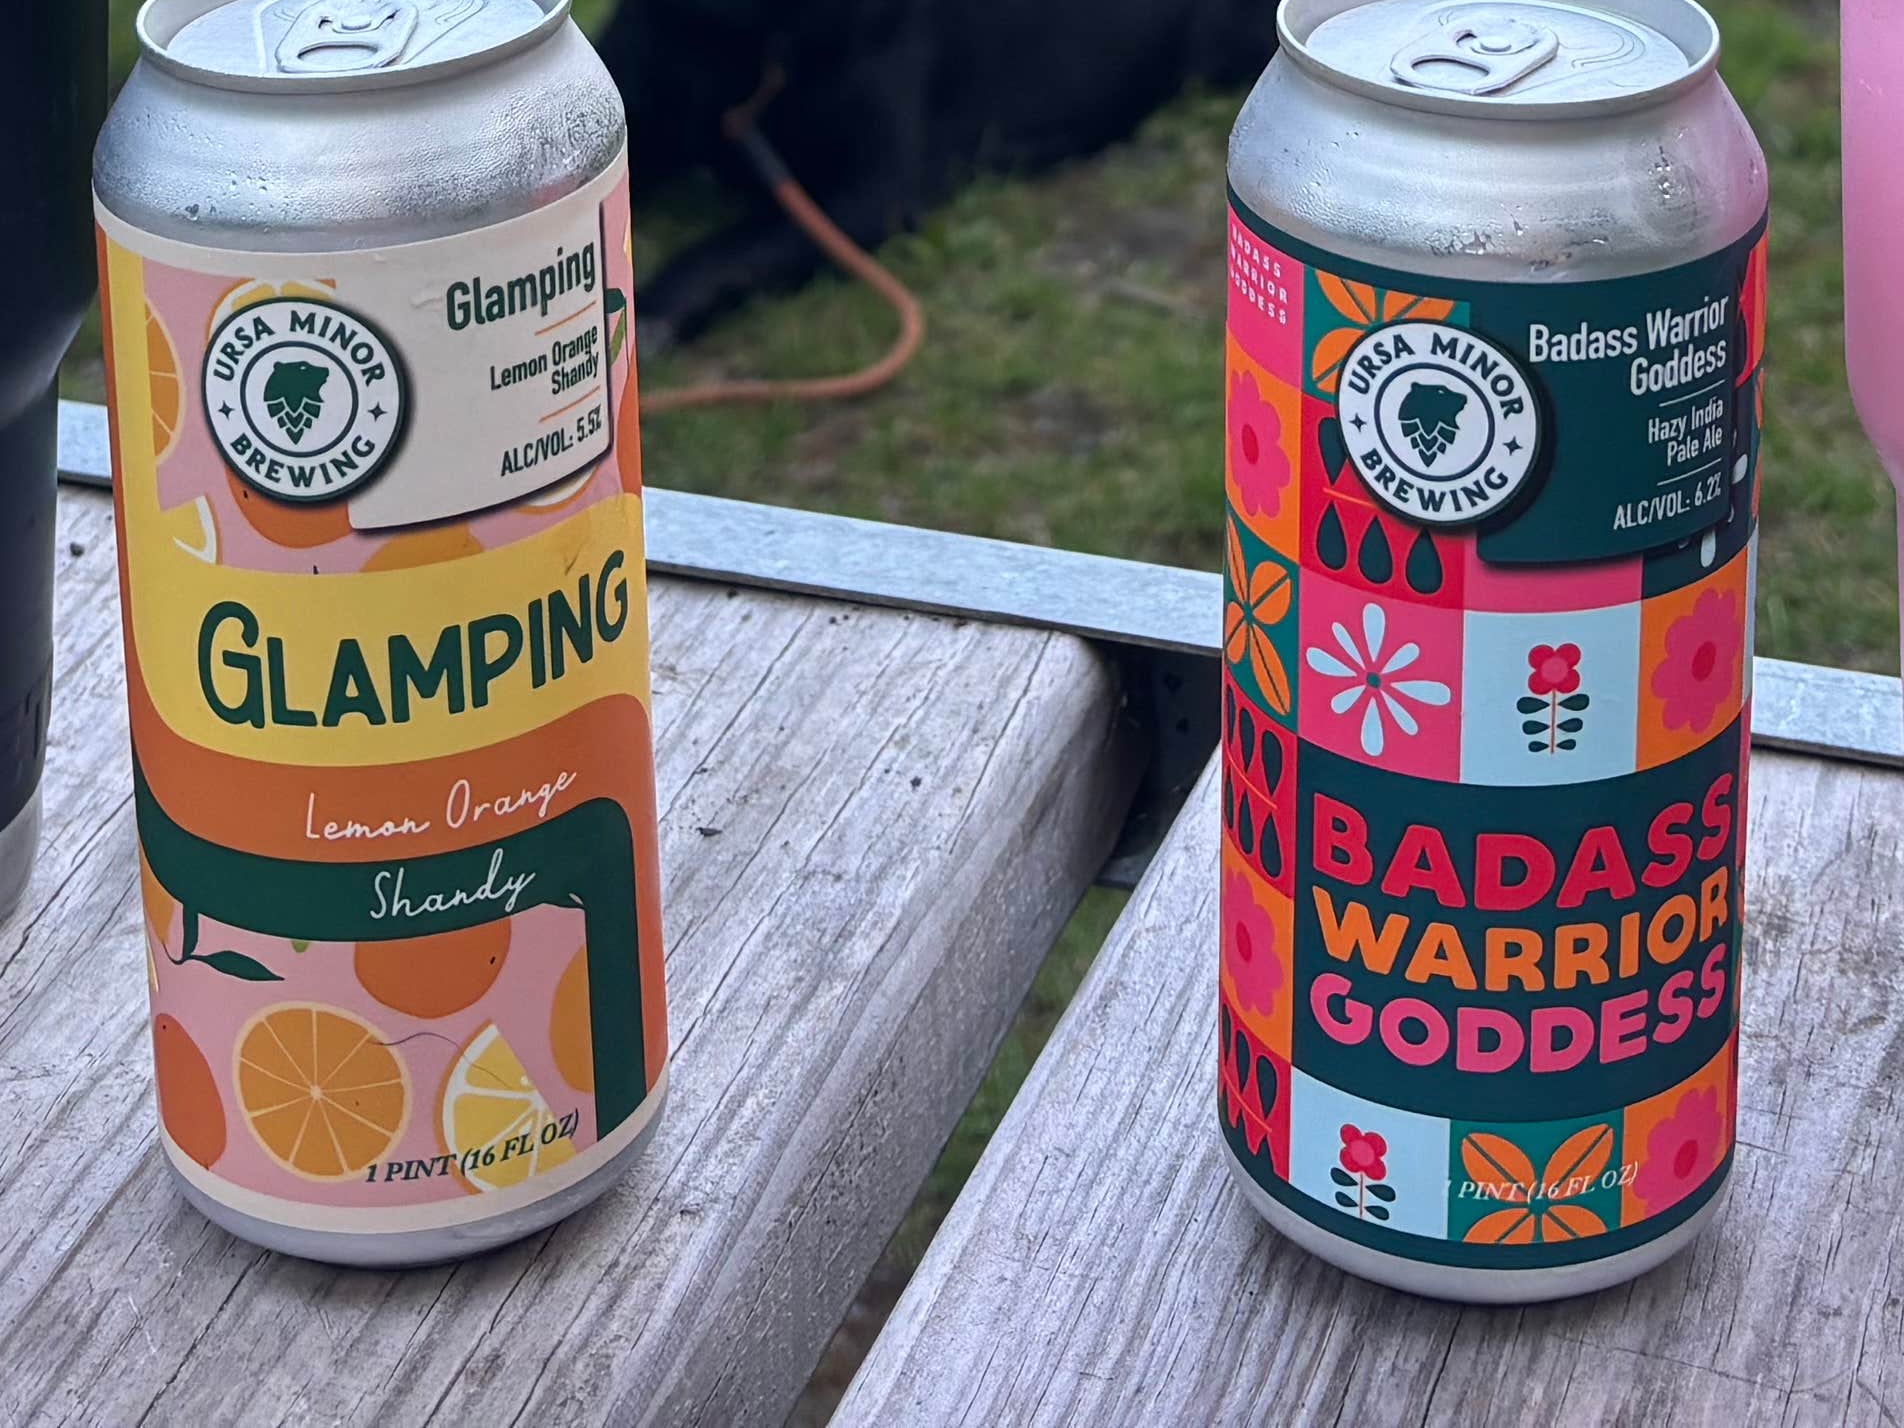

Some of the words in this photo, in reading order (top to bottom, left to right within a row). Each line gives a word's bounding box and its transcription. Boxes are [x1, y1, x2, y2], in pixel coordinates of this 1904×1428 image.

[446, 241, 596, 332] Glamping
[213, 315, 277, 382] URSA
[289, 309, 386, 387] MINOR
[490, 351, 548, 391] Lemon
[551, 325, 598, 366] Orange
[1529, 321, 1638, 363] Badass
[1646, 296, 1729, 350] Warrior
[551, 349, 600, 395] Shandy
[1347, 333, 1416, 396] URSA
[1429, 331, 1525, 420] MINOR
[1630, 339, 1727, 396] Goddess
[576, 404, 602, 443] 5.5%
[1648, 414, 1687, 444] Hazy
[1691, 396, 1724, 430] India
[1667, 438, 1699, 466] Pale
[1702, 426, 1723, 453] Ale
[229, 432, 376, 488] BREWING
[1360, 447, 1509, 513] BREWING
[196, 549, 629, 729] GLAMPING
[305, 791, 431, 841] Lemon
[445, 770, 578, 829] Orange
[1311, 772, 1733, 912] BADASS
[369, 847, 536, 920] Shandy
[1311, 865, 1730, 992] WARRIOR
[1309, 943, 1727, 1074] GODDESS
[365, 1164, 378, 1183] 1
[383, 1153, 458, 1183] PINT
[459, 1150, 496, 1177] (16
[499, 1133, 535, 1162] FL
[540, 1108, 580, 1146] OZ)
[1457, 1179, 1526, 1202] PINT
[1527, 1179, 1561, 1205] (16
[1565, 1175, 1596, 1197] FL
[1600, 1160, 1640, 1189] OZ)
